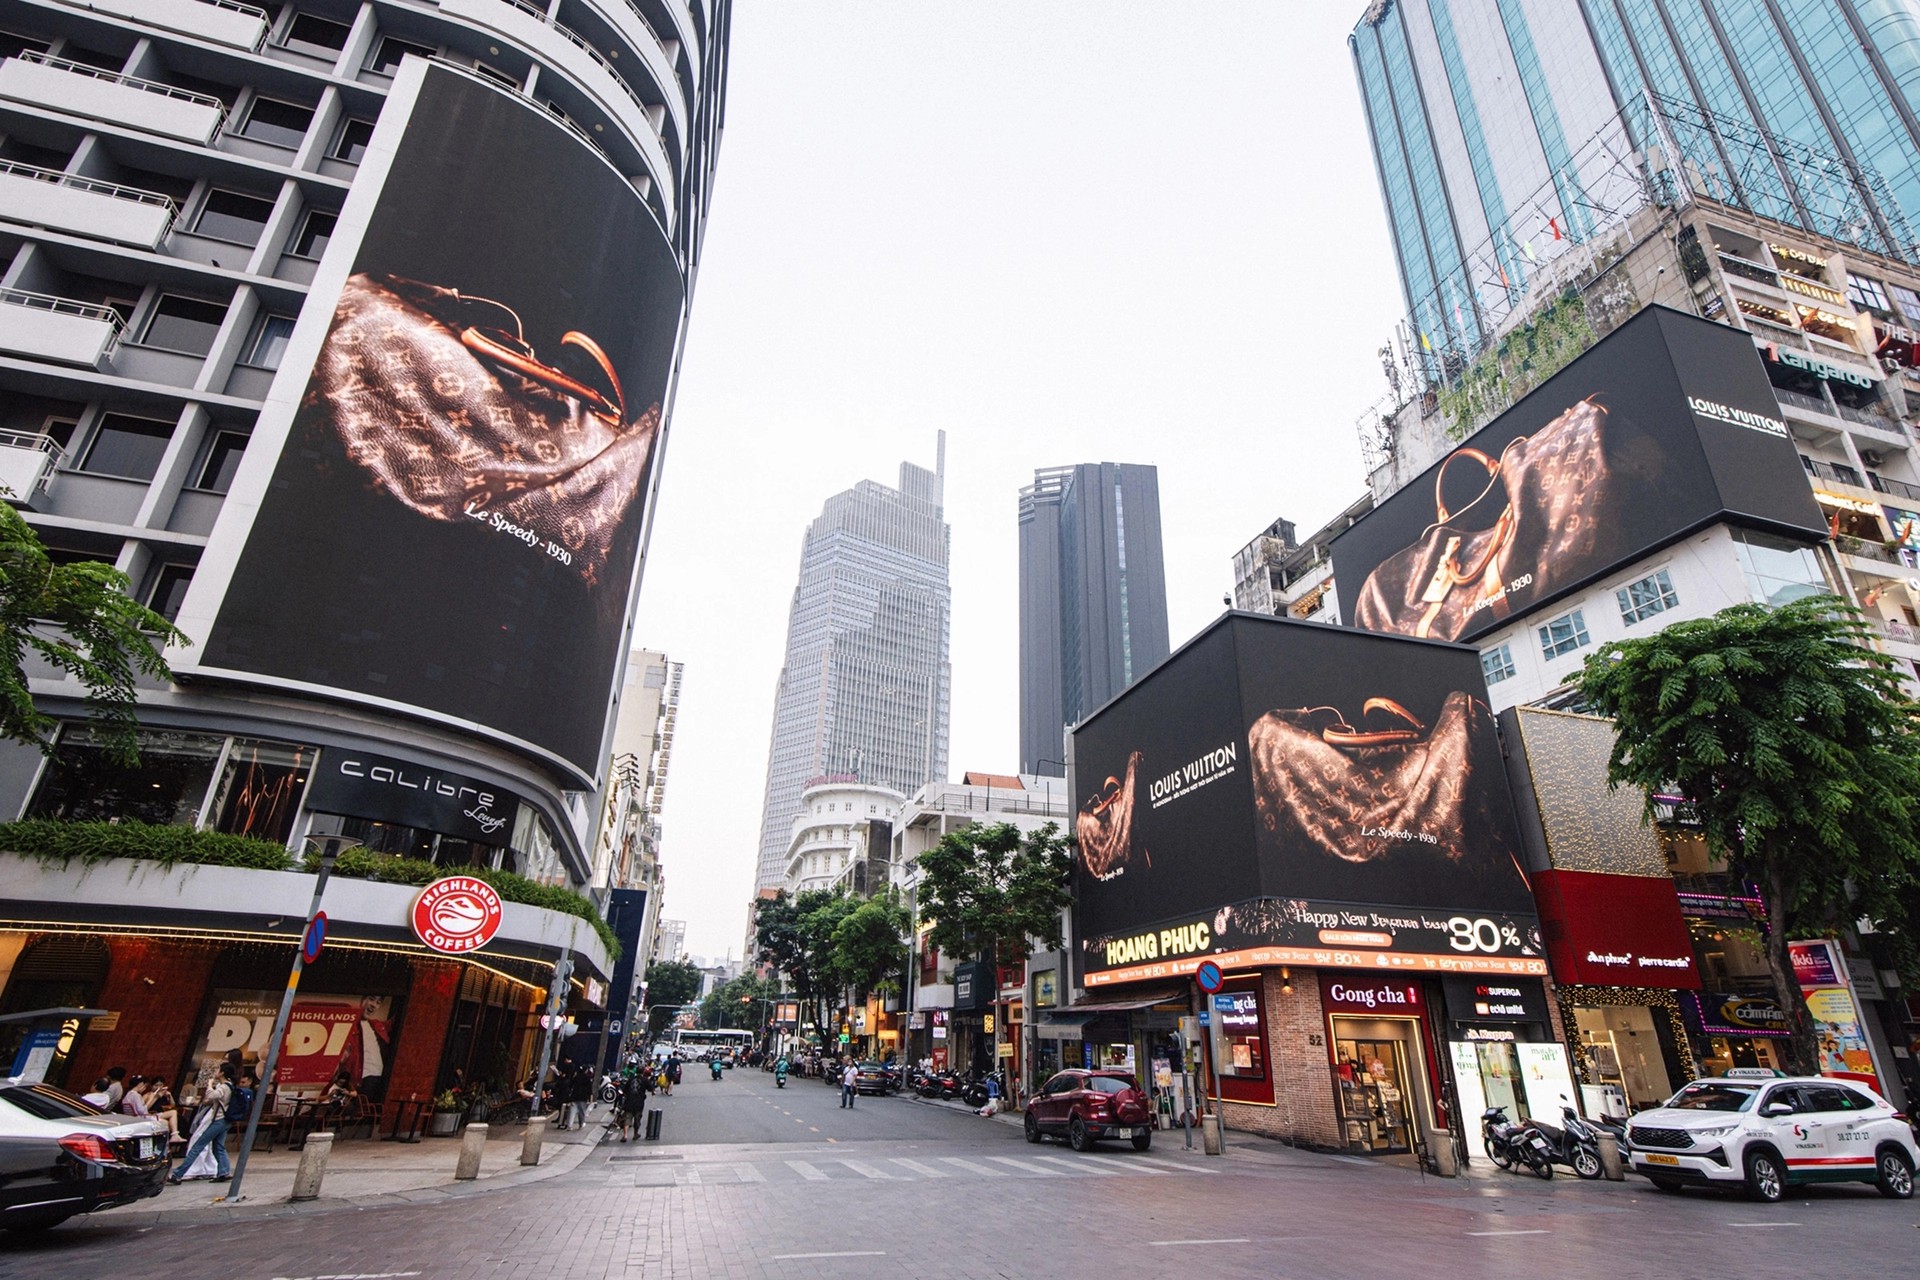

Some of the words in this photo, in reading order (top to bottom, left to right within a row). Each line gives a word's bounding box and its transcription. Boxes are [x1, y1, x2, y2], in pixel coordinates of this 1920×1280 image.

[1766, 342, 1872, 389] Kangaroo
[1688, 396, 1729, 418] LOUIS
[1730, 408, 1787, 434] VUITTON
[464, 502, 489, 521] Le
[489, 512, 539, 547] Speedy
[547, 541, 572, 566] 1930
[1511, 573, 1532, 592] 1930
[1150, 770, 1181, 801] LOUIS
[1183, 742, 1236, 784] VUITTON
[1361, 825, 1376, 836] Le
[1378, 826, 1413, 842] Speedy
[1419, 832, 1437, 845] 1930
[422, 880, 500, 915] HIGHLANDS
[1296, 909, 1338, 928] Happy
[1340, 912, 1367, 927] New
[424, 928, 485, 951] COFFEE
[1107, 933, 1158, 965] HOANG
[1160, 922, 1210, 956] PHUC
[1638, 957, 1662, 967] pierre
[1663, 956, 1690, 968] cardin
[1331, 984, 1376, 1008] Gong
[1377, 986, 1406, 1004] cha
[1488, 987, 1521, 996] SUPERGA
[218, 1007, 277, 1015] HIGHLANDS
[292, 1012, 357, 1022] HIGHLANDS
[1309, 1034, 1322, 1046] 52
[1479, 1029, 1514, 1041] Kappa
